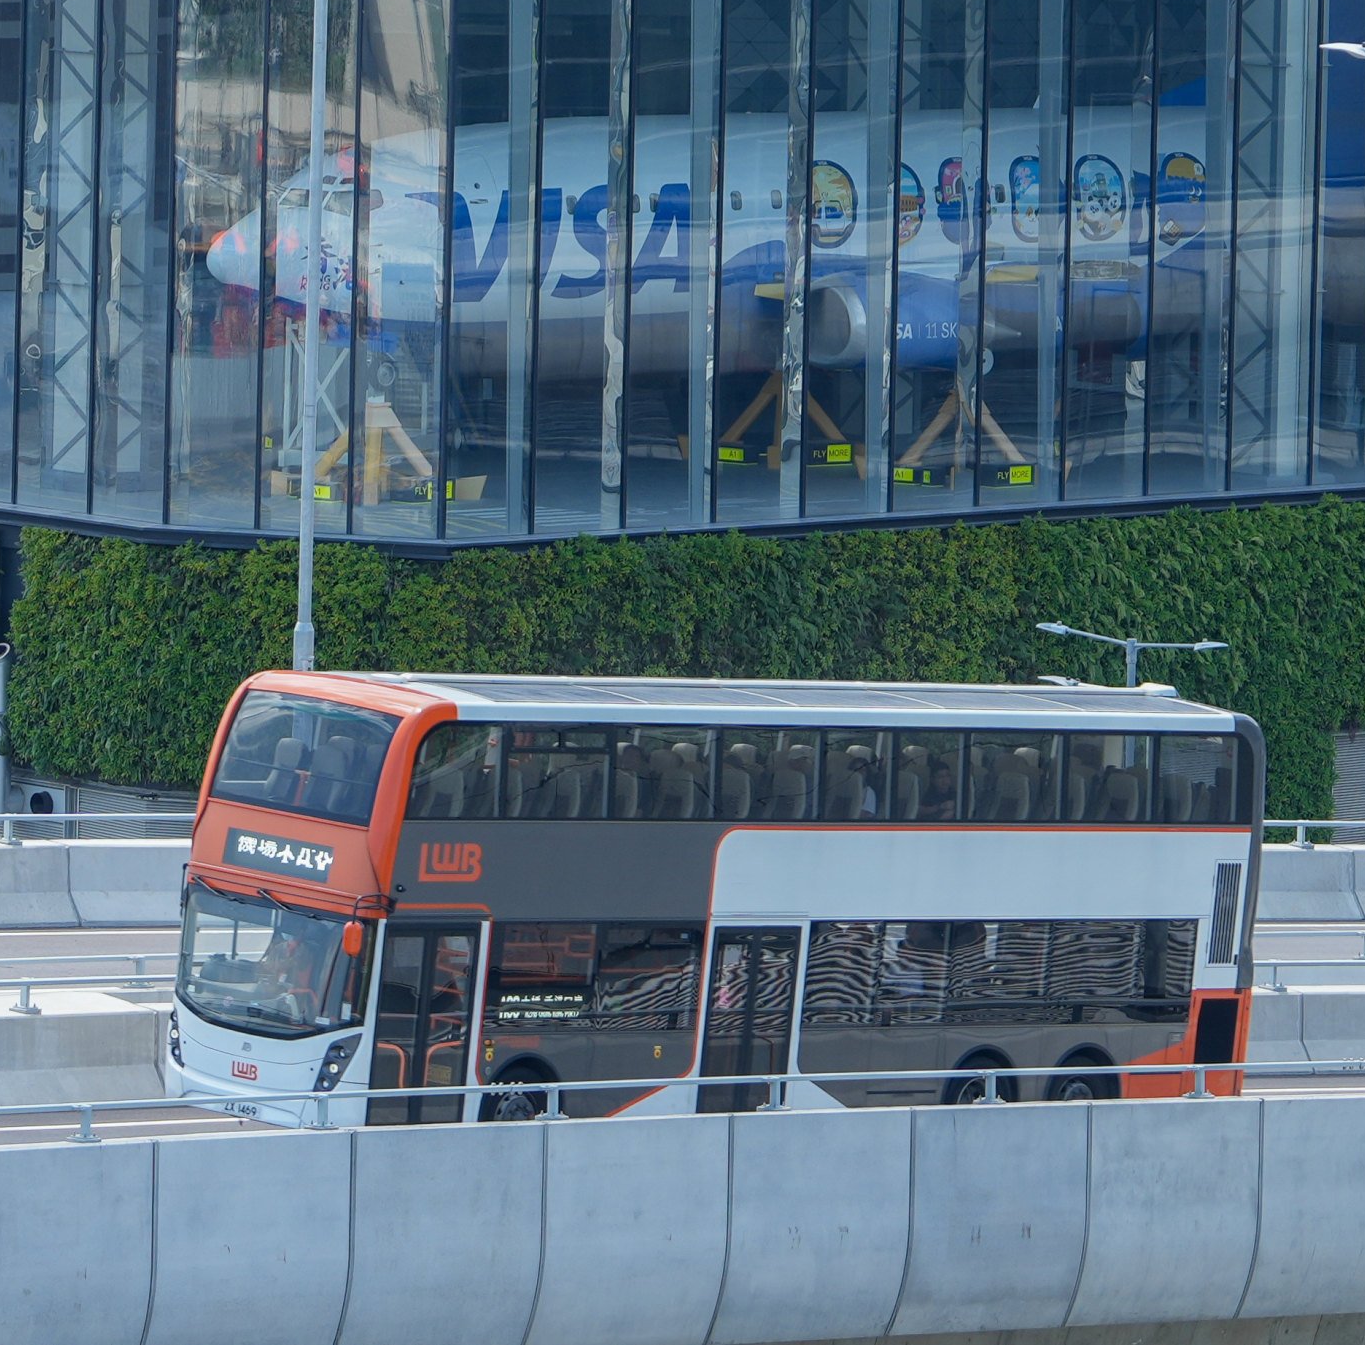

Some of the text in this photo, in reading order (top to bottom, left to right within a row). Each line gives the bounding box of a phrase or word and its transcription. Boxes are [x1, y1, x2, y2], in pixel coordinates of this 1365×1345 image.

[997, 470, 1030, 480] FLY MORE
[418, 842, 483, 883] LWB
[231, 1060, 258, 1081] LWB
